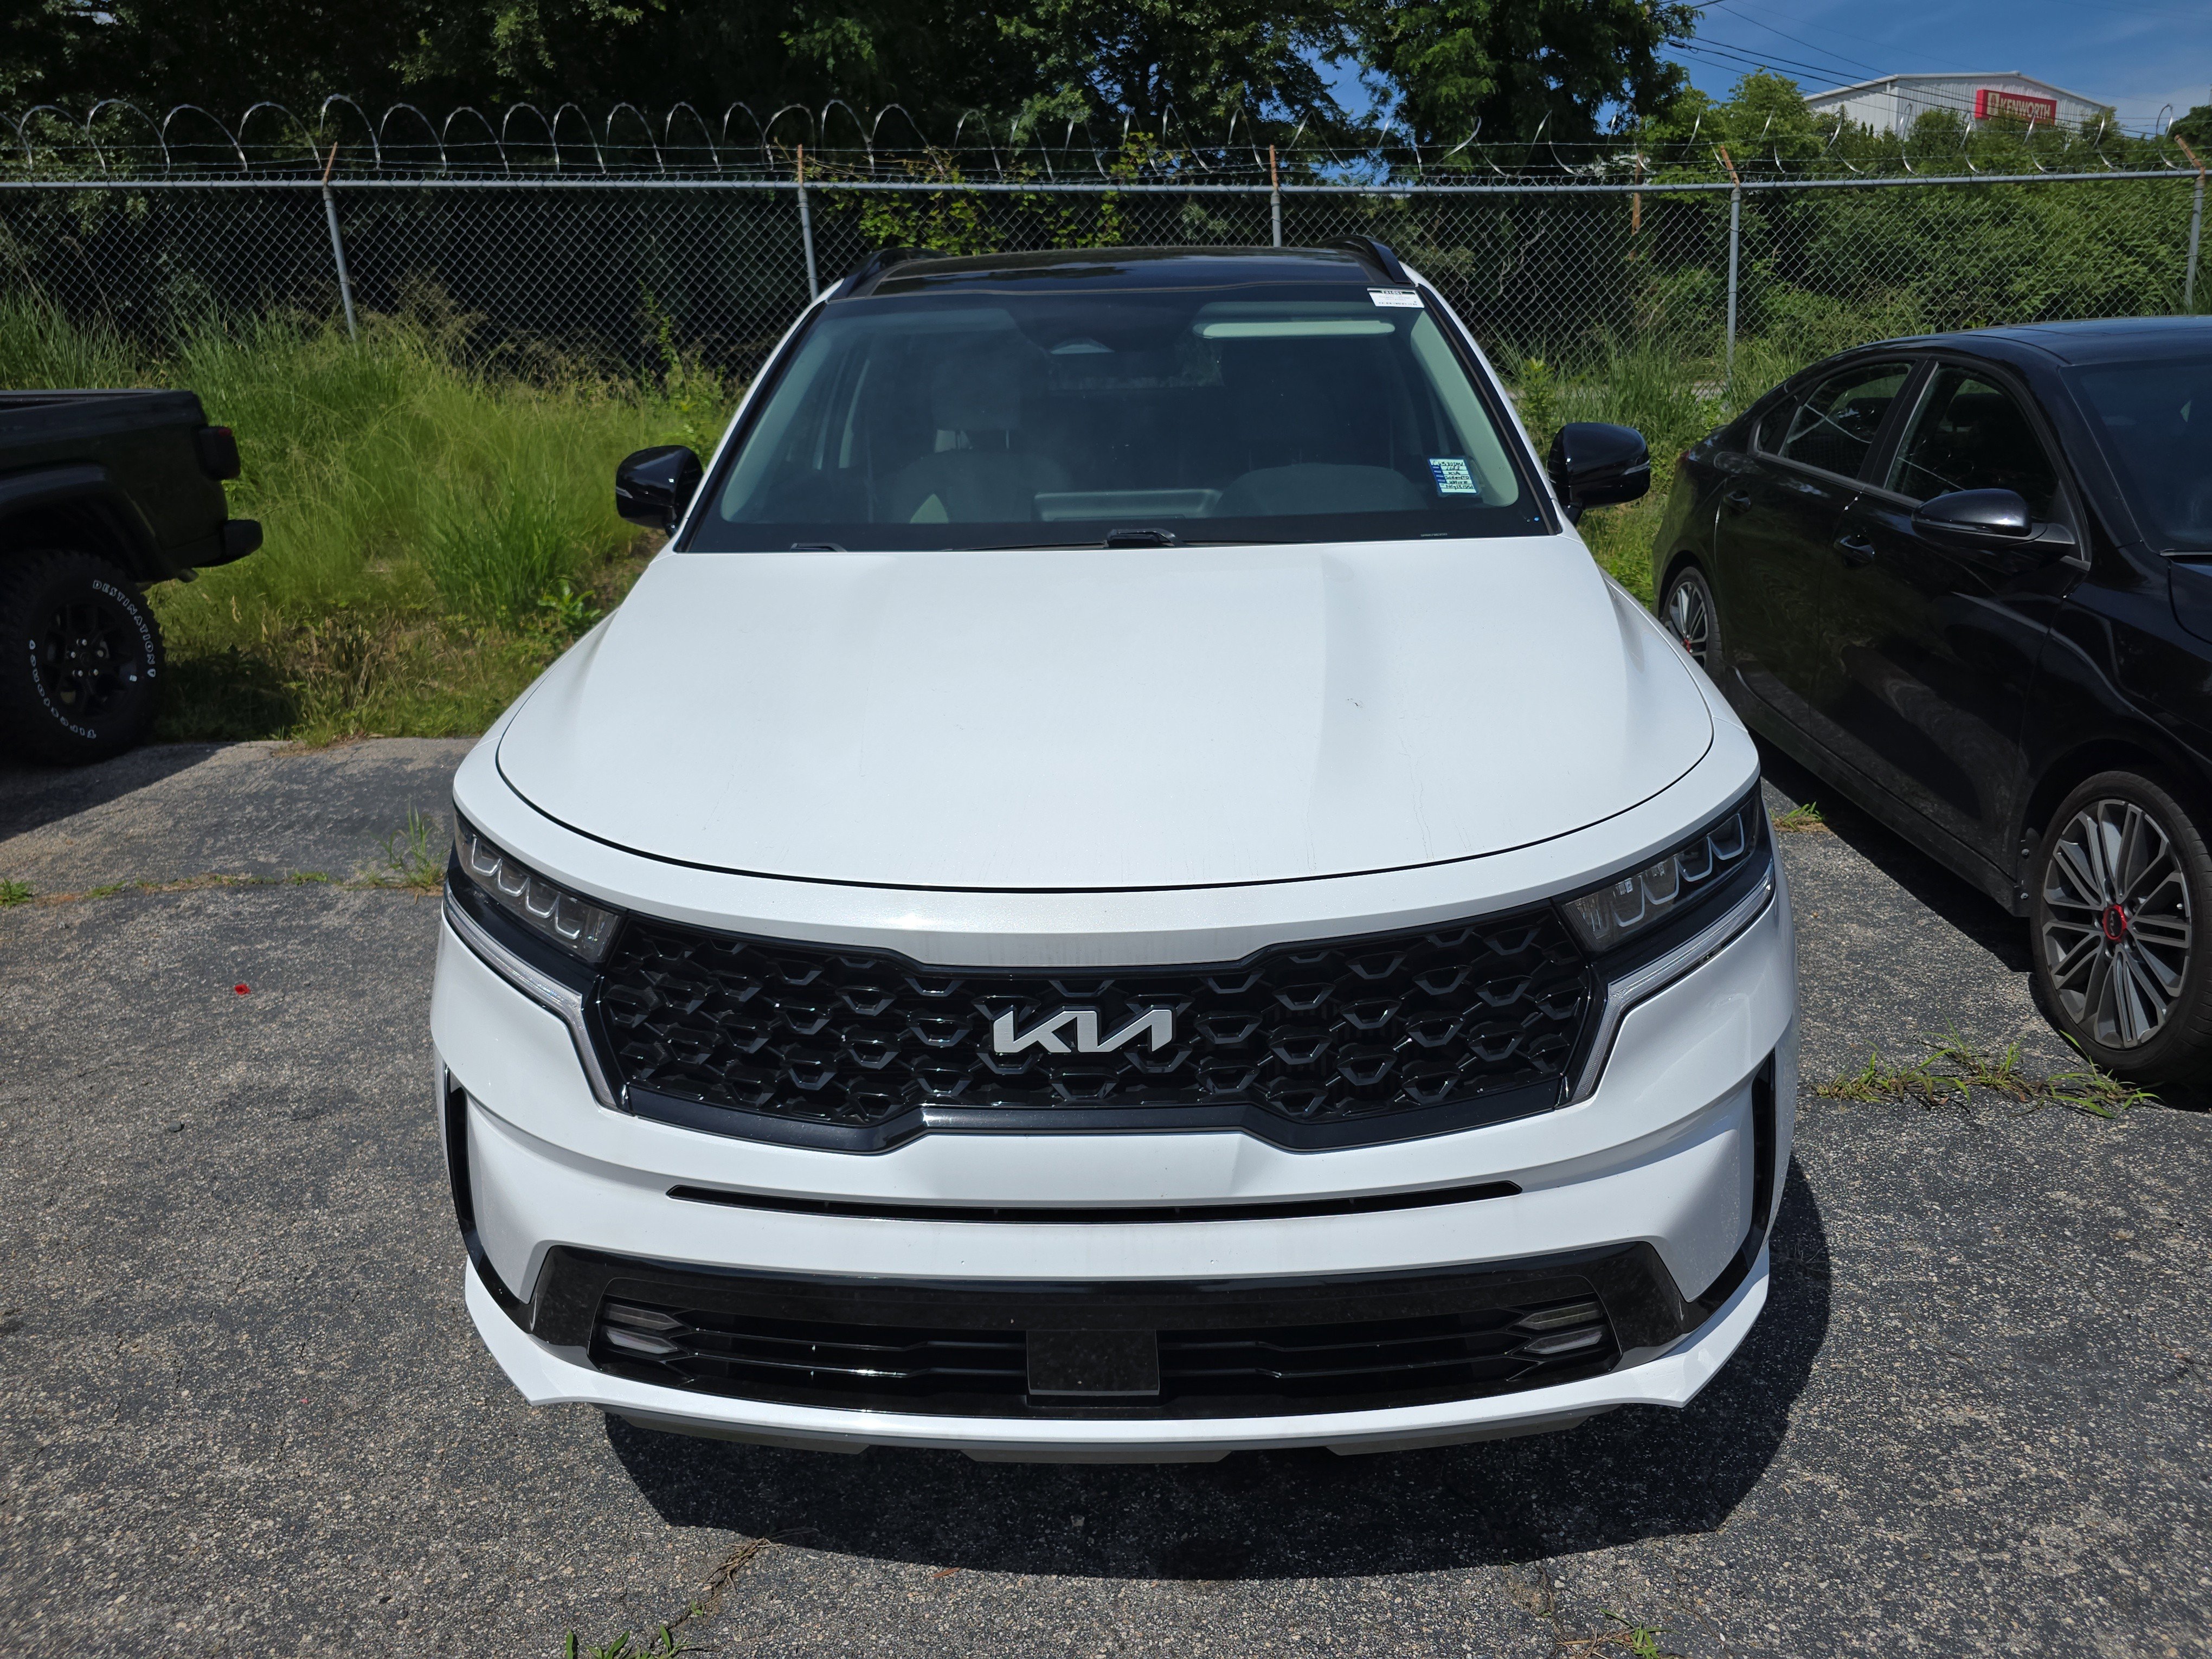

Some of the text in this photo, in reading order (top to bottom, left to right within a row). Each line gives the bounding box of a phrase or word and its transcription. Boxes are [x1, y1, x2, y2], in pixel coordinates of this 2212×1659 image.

[2000, 98, 2051, 120] KENWORTH
[92, 579, 156, 665] DESTINATION
[993, 1009, 1173, 1053] KIA
